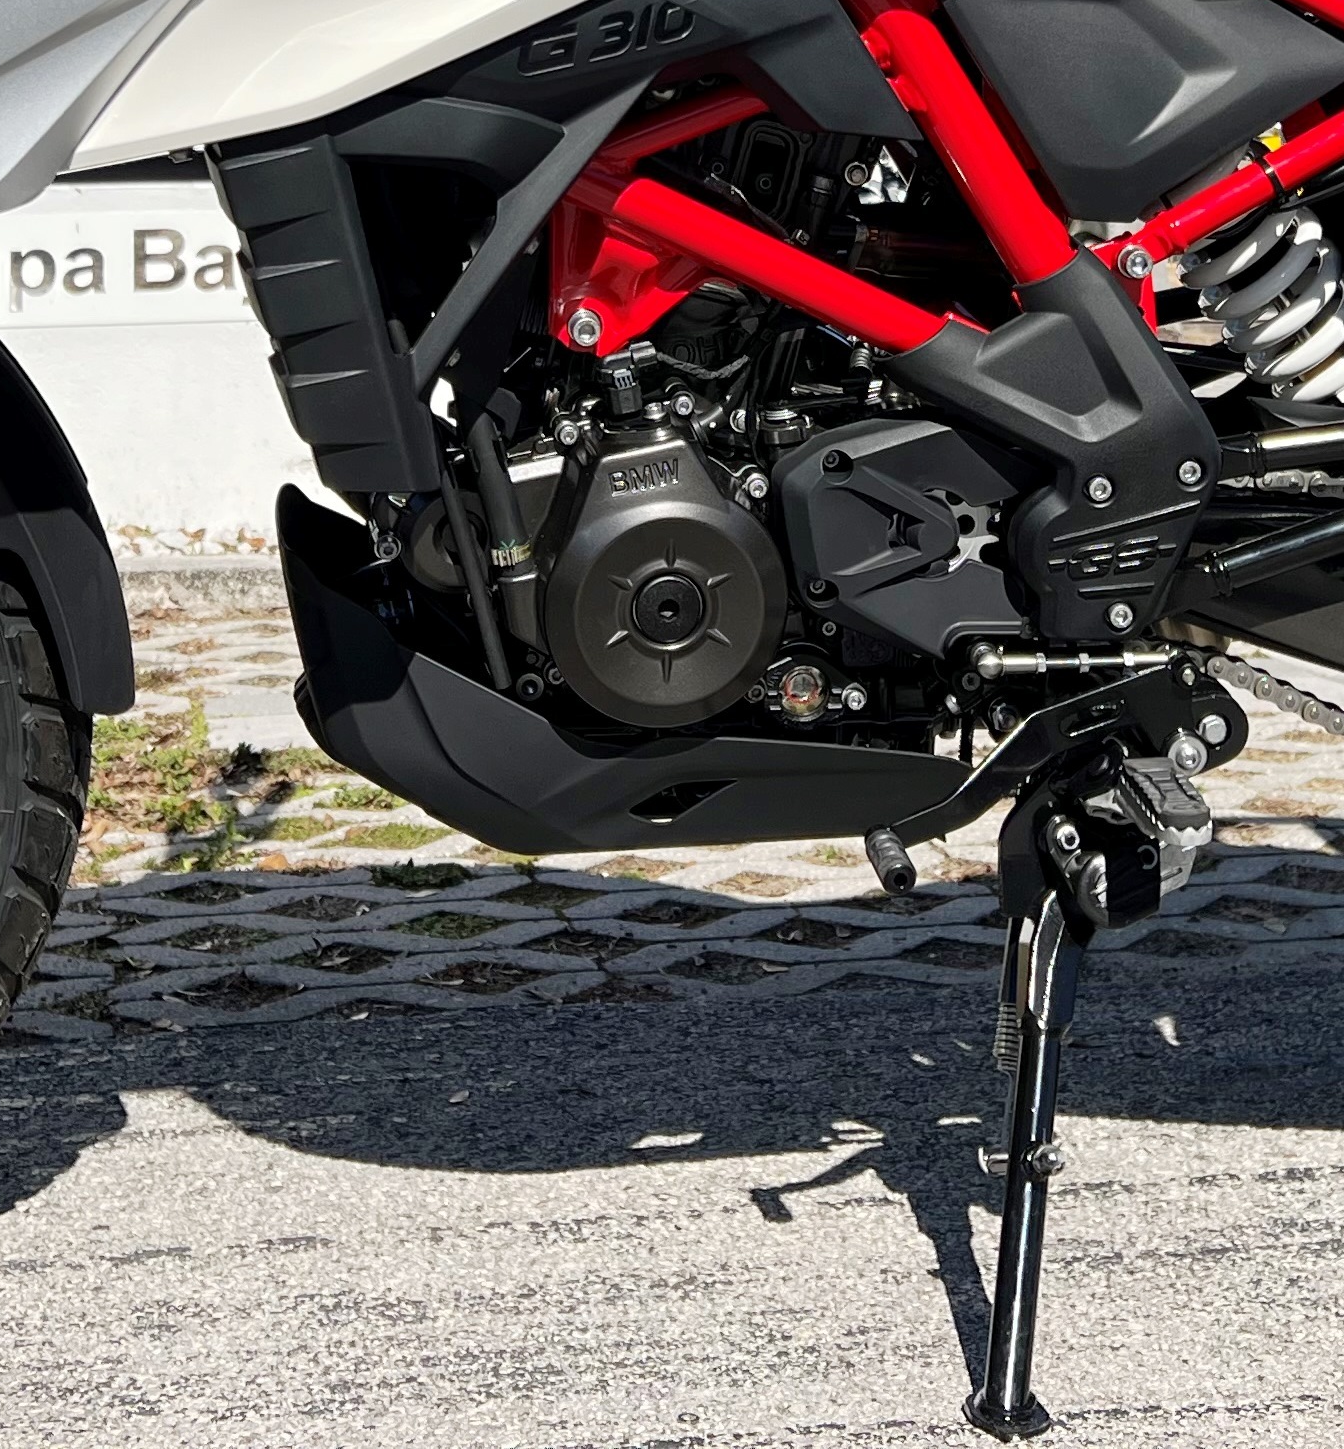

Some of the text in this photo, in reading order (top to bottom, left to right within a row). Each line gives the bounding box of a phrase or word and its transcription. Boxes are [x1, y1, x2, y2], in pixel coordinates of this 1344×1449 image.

[589, 1, 696, 63] 310
[133, 228, 250, 306] Ba
[607, 457, 681, 497] BMW
